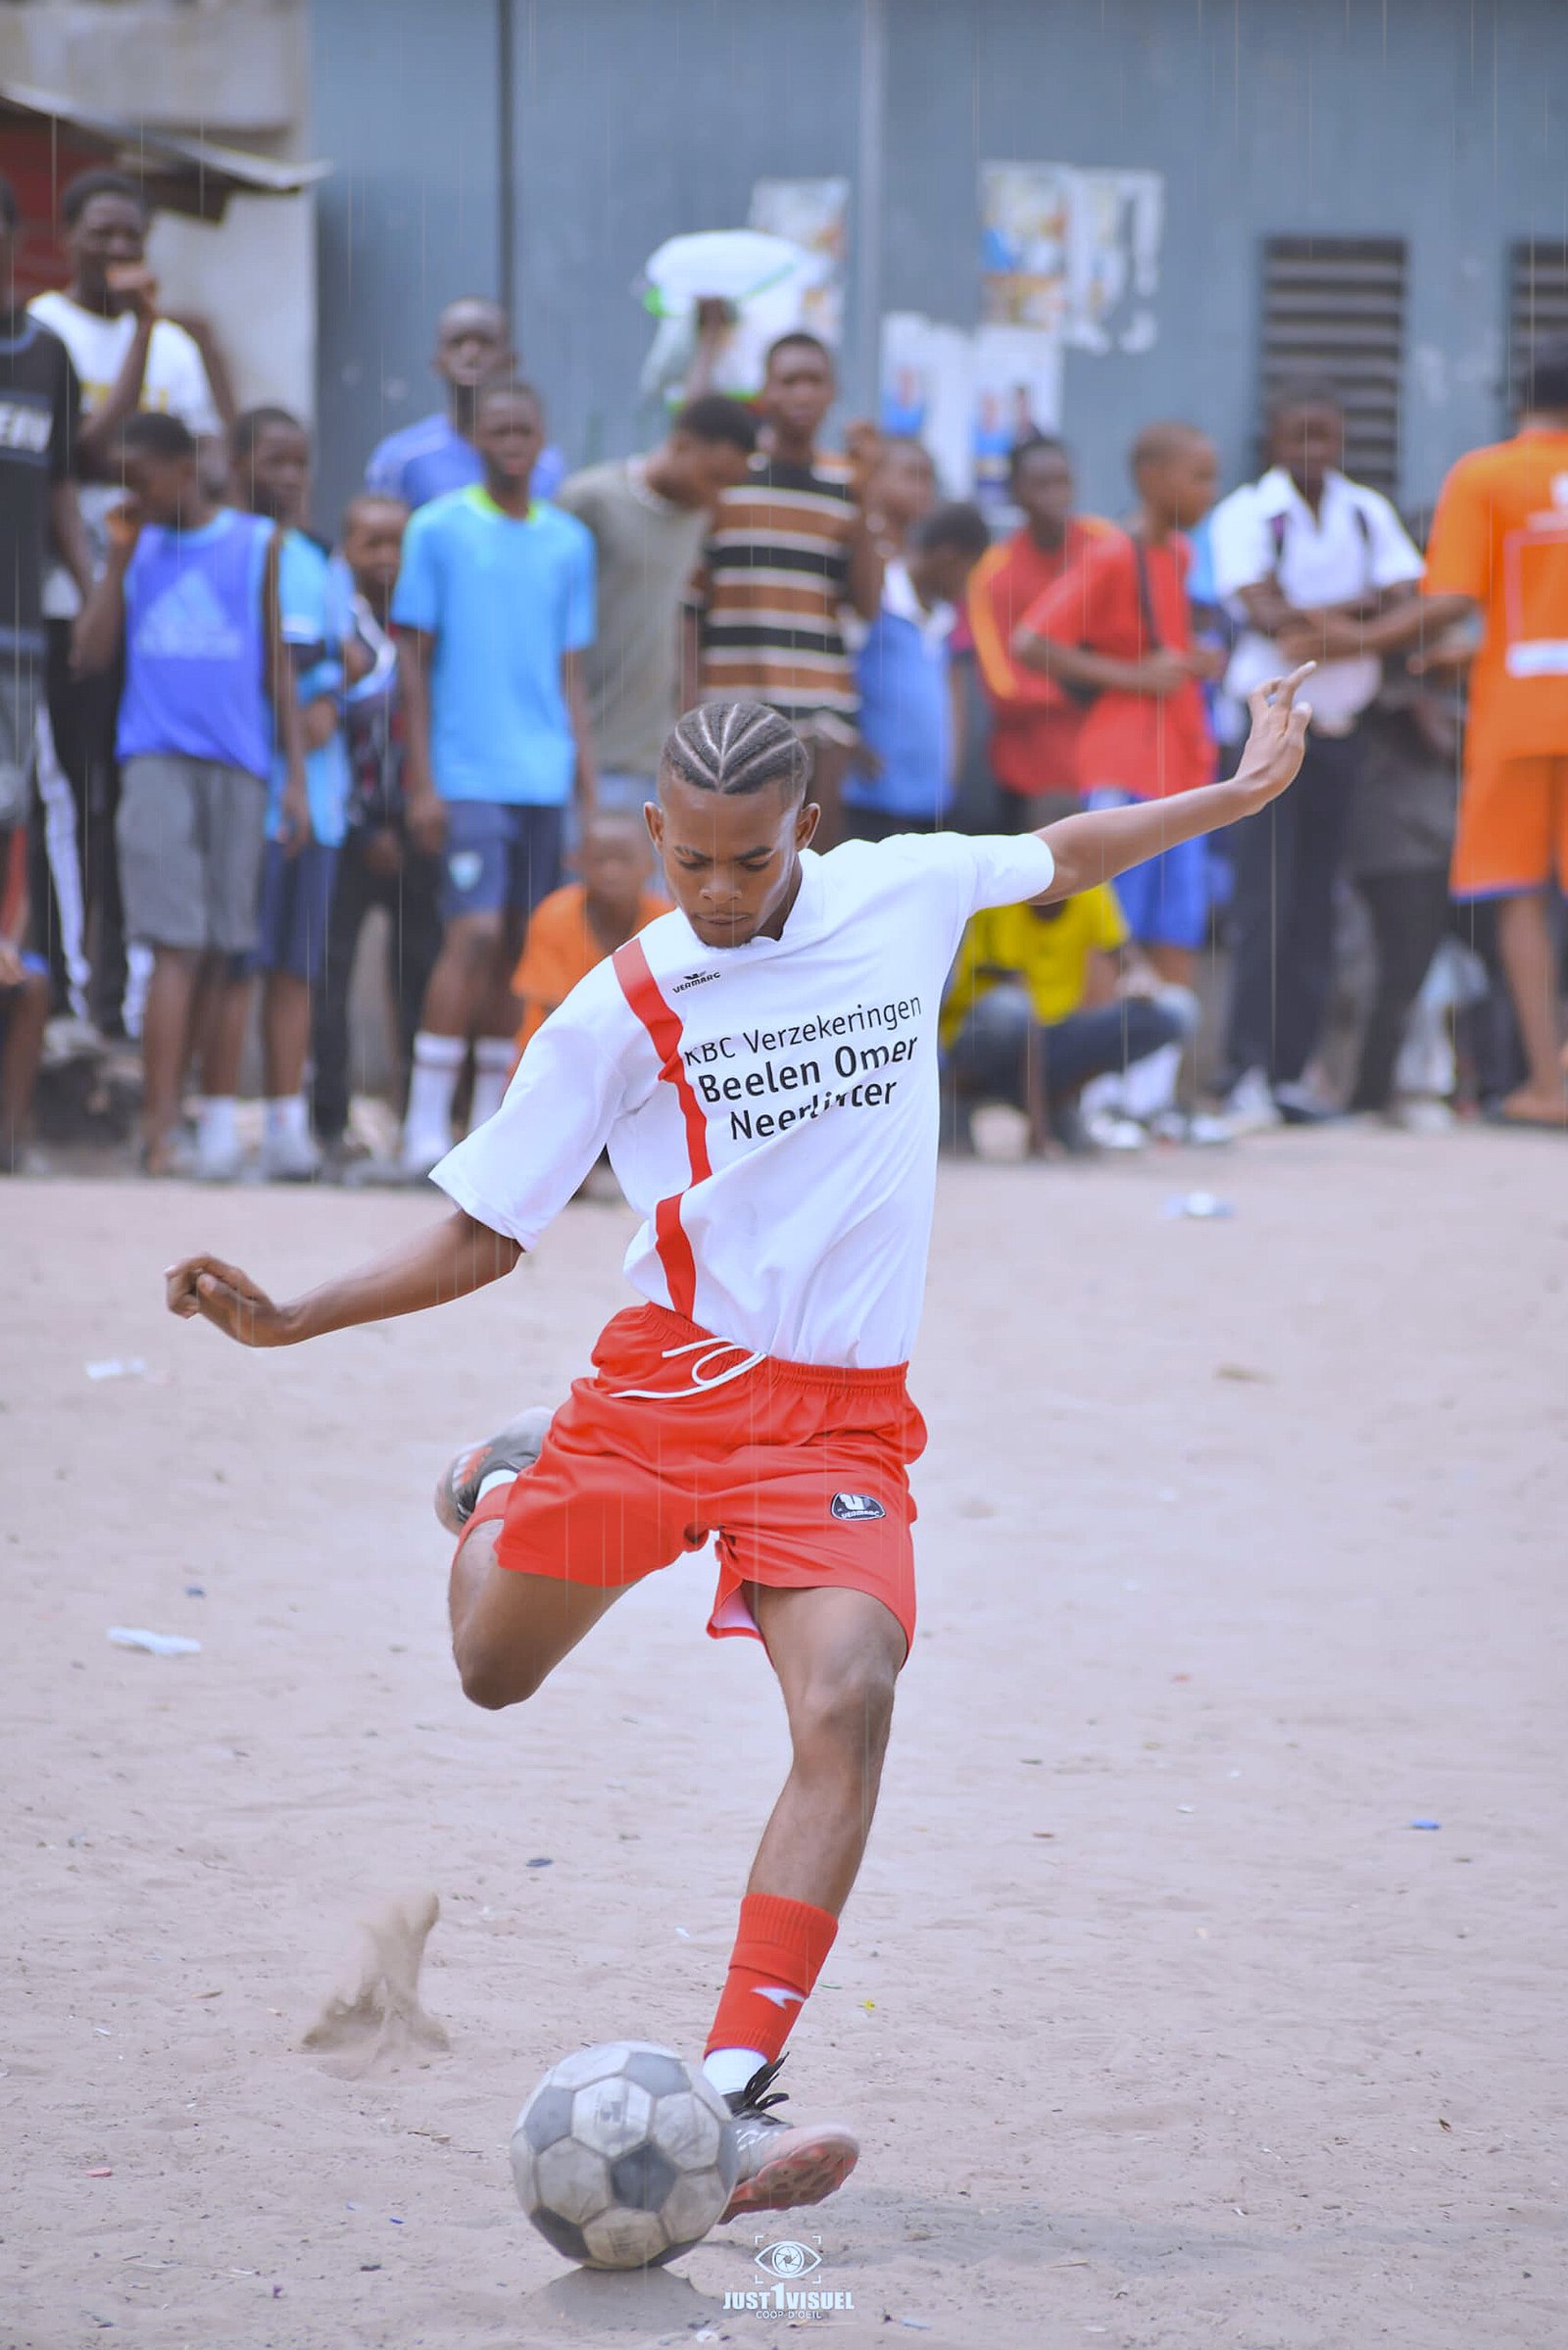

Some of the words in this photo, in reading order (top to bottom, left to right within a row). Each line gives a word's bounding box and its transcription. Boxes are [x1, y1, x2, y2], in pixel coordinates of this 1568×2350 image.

[672, 971, 720, 994] VERMARC
[684, 1037, 736, 1066] KBC
[743, 996, 921, 1053] Verzekeringen
[698, 1059, 821, 1103] Beelen
[834, 1036, 918, 1079] Omer
